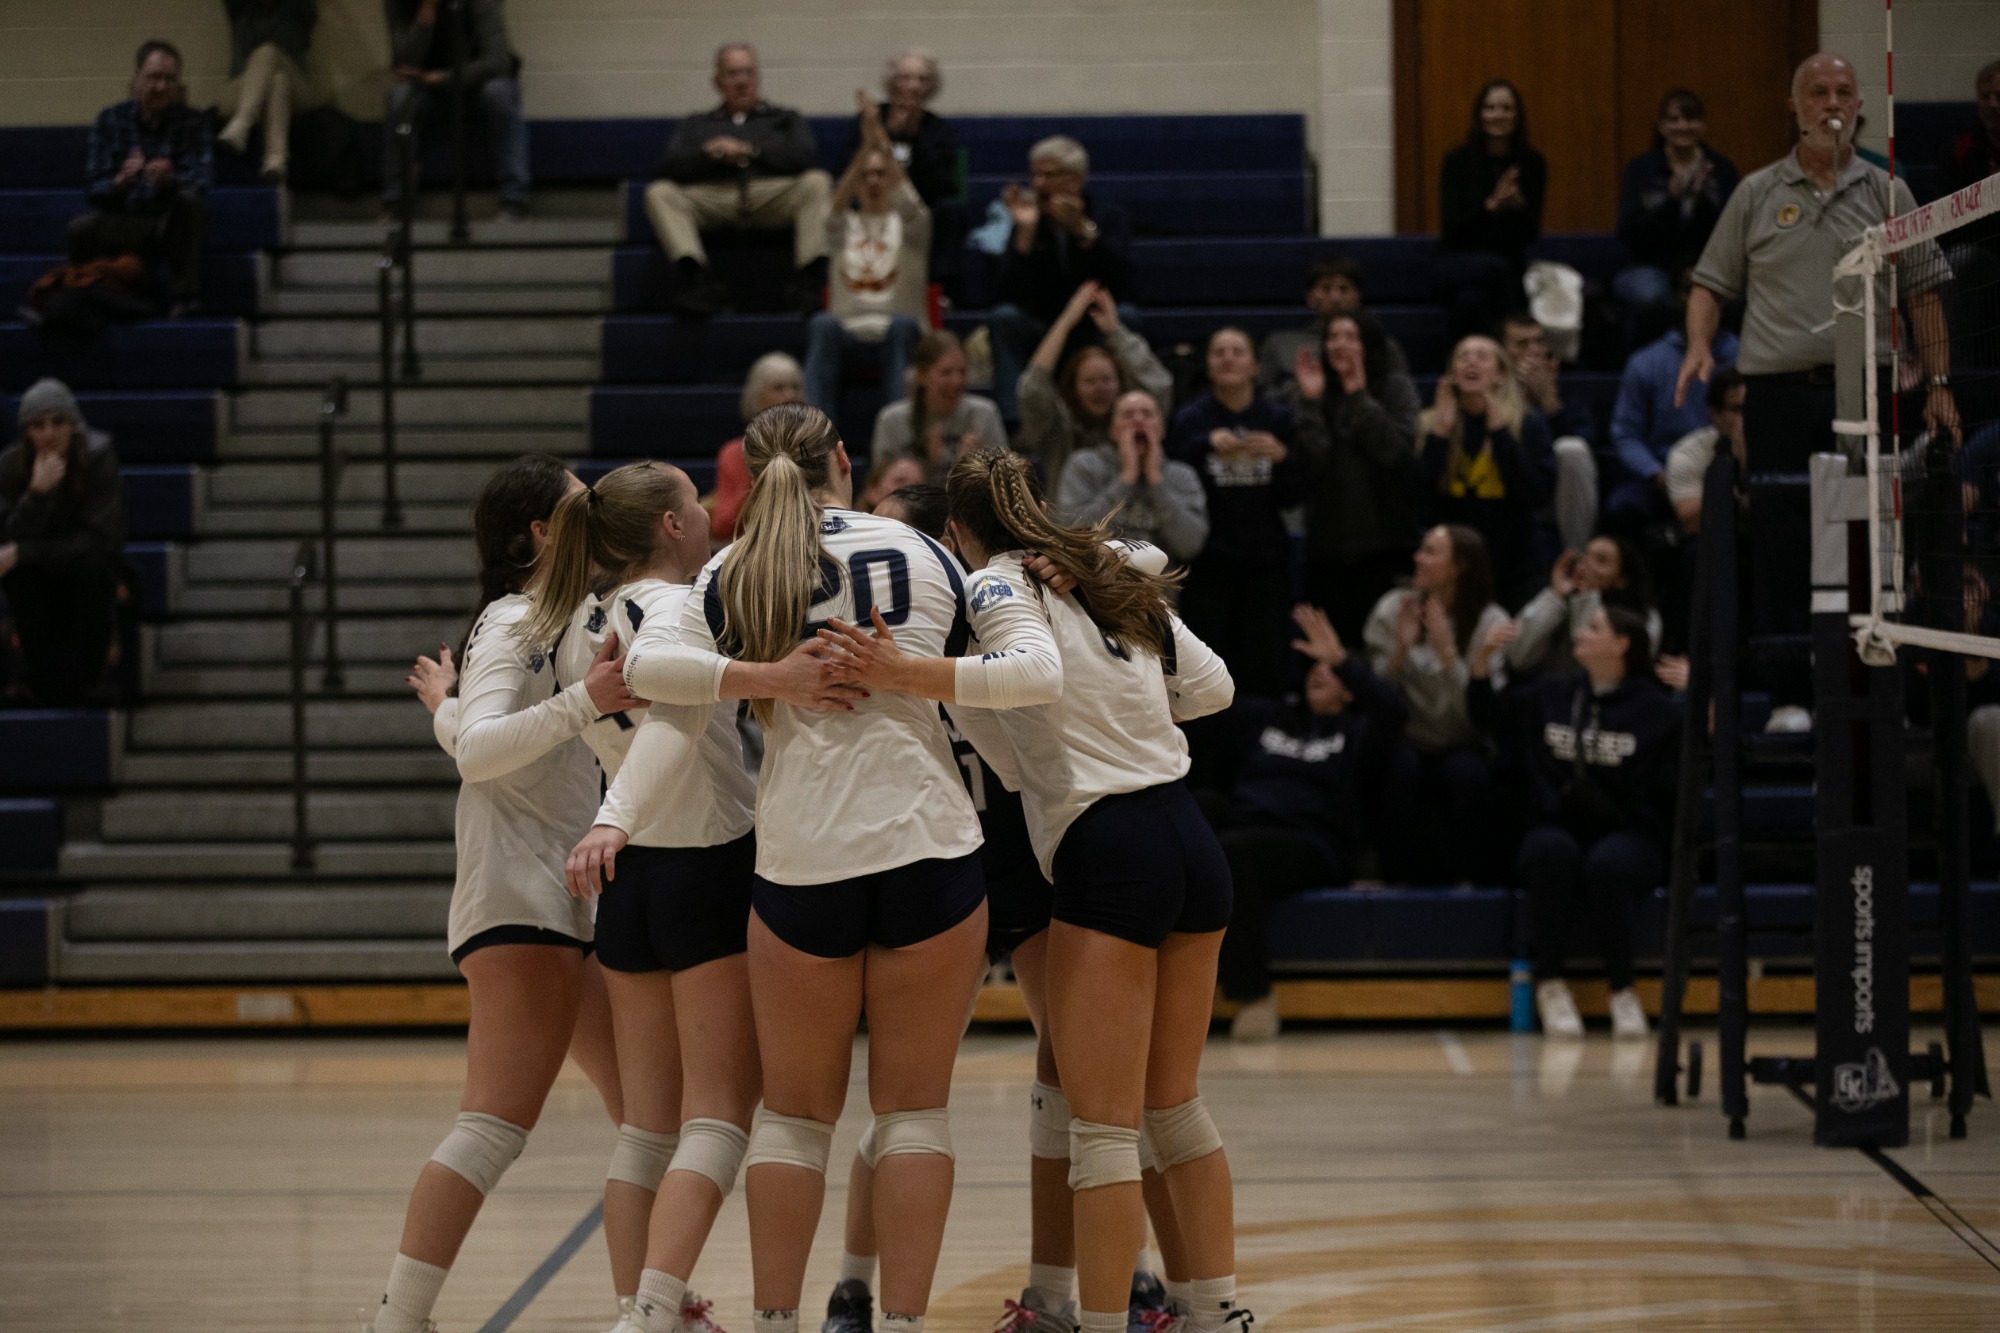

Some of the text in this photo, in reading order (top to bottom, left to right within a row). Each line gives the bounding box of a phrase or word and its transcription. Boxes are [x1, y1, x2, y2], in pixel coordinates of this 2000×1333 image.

[800, 547, 912, 640] 20
[1850, 865, 1875, 1034] sports imports
